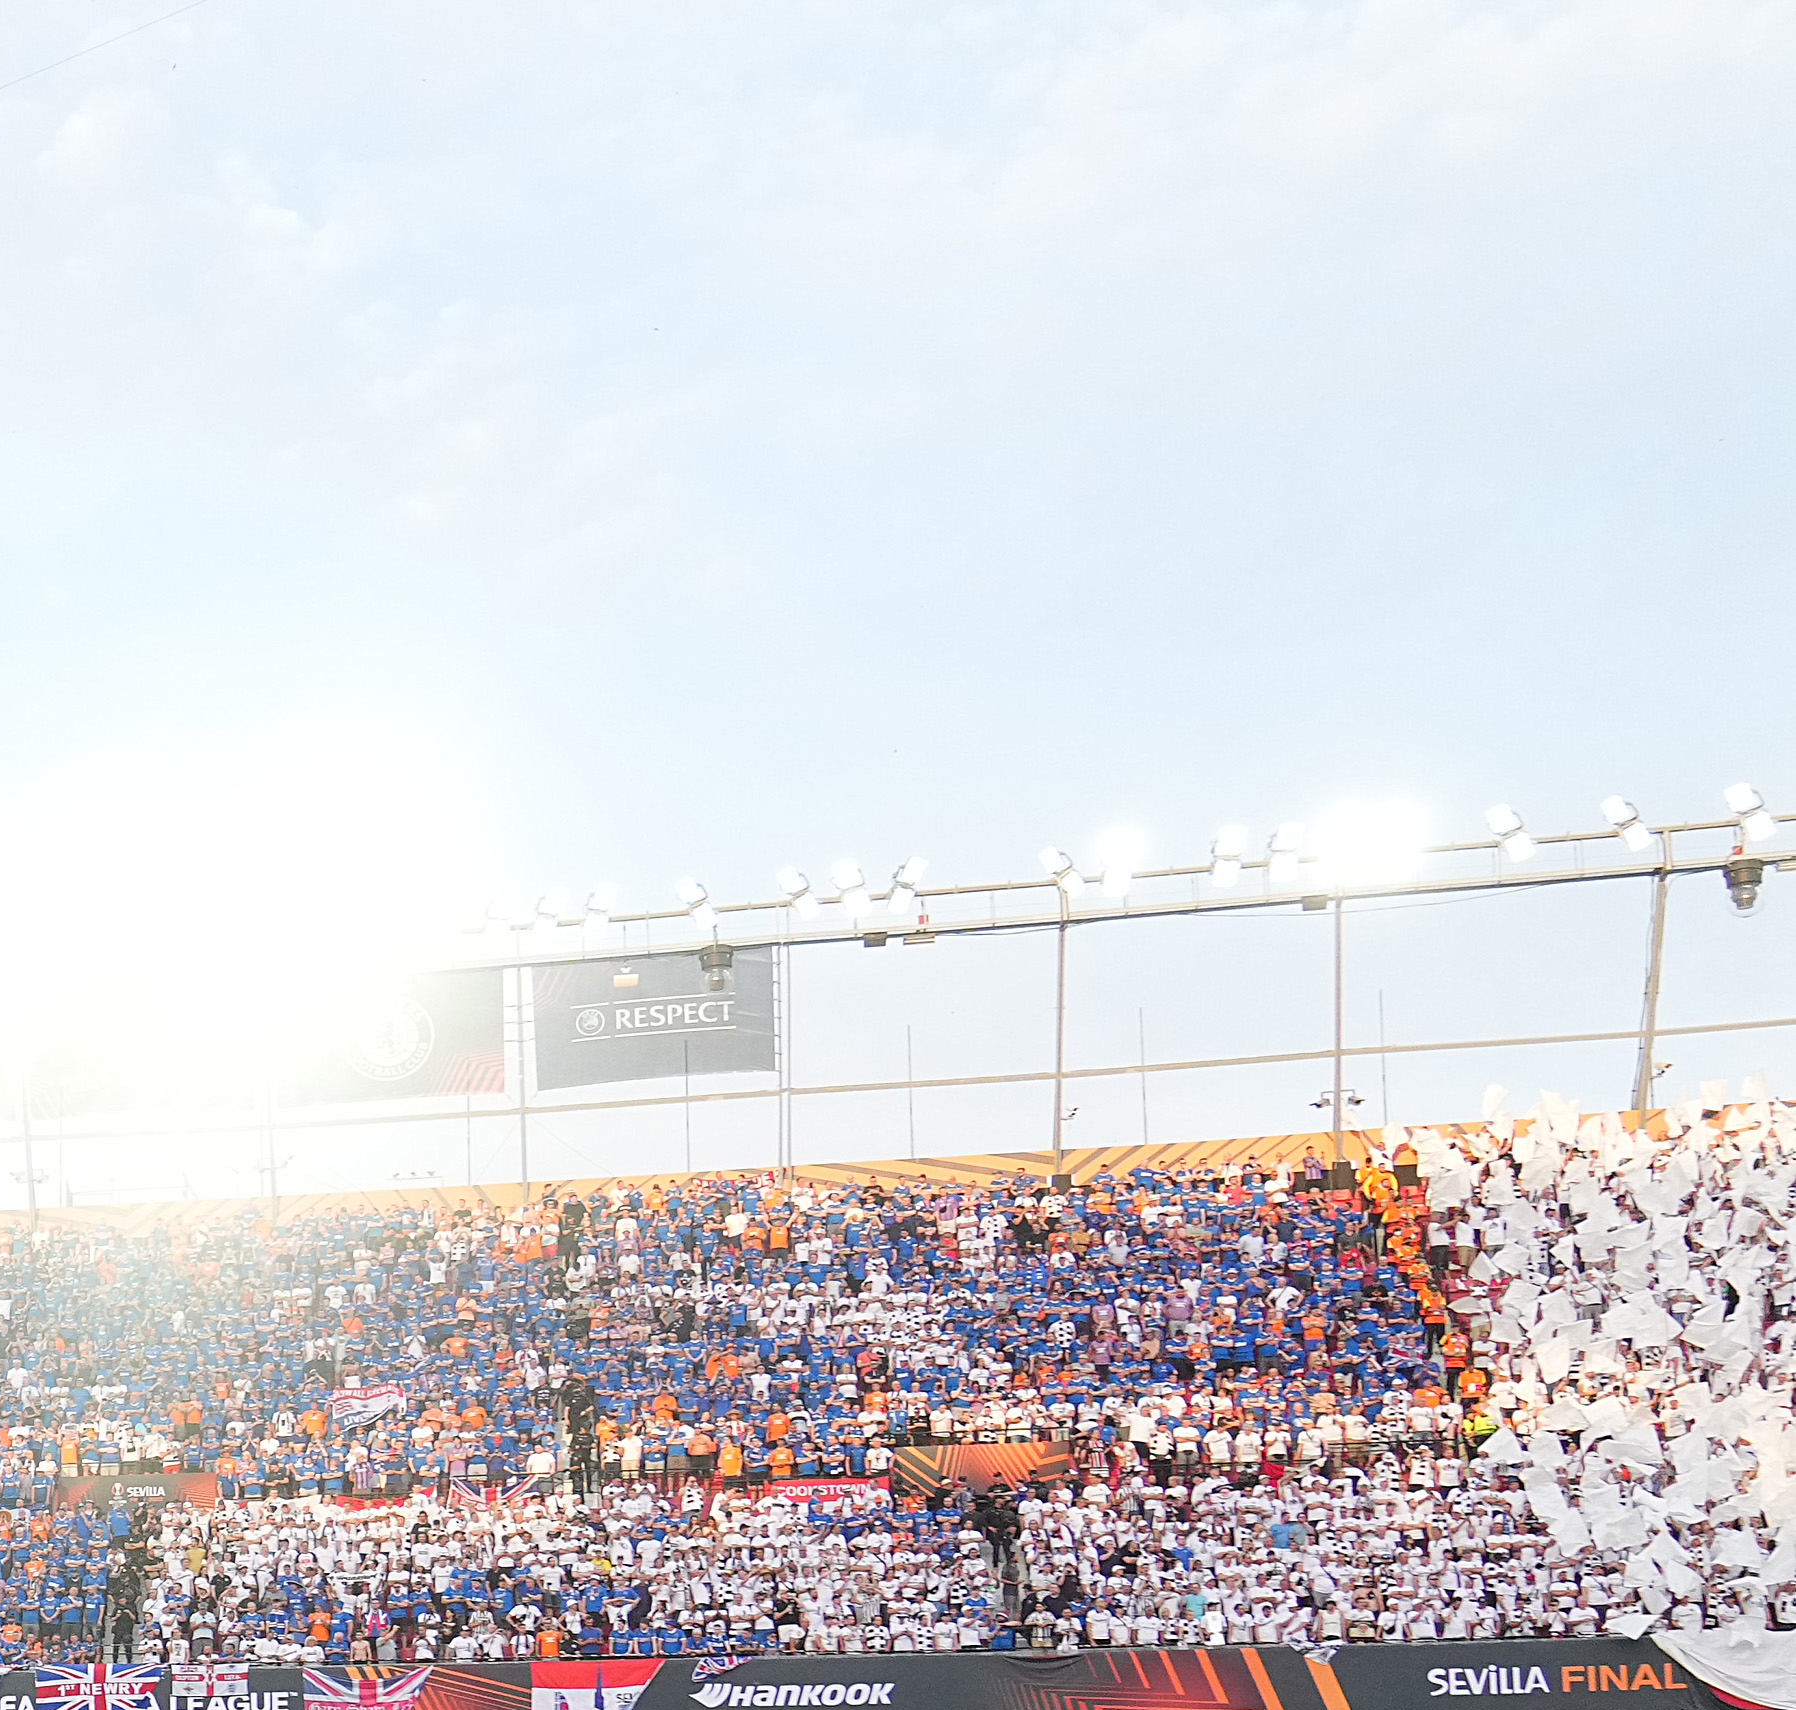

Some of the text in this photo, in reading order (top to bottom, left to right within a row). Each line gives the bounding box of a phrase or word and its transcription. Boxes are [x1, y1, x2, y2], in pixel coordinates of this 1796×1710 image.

[615, 1001, 735, 1030] RESPECT
[79, 1682, 143, 1696] NEWRY
[1562, 1663, 1688, 1694] FINAL
